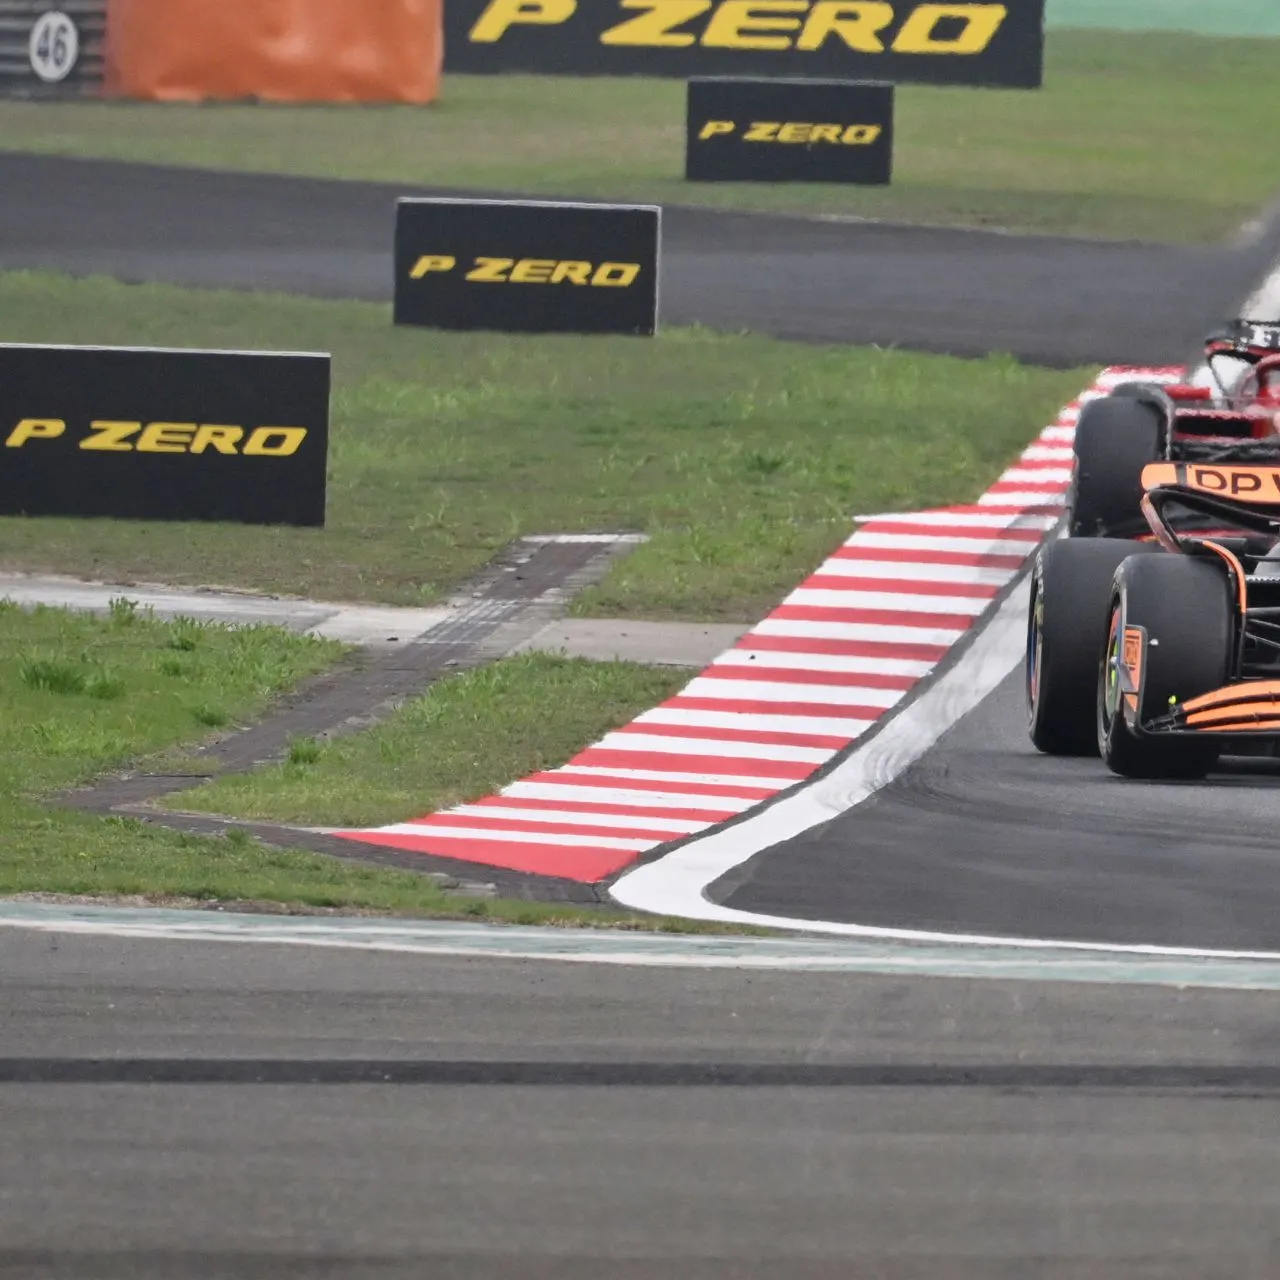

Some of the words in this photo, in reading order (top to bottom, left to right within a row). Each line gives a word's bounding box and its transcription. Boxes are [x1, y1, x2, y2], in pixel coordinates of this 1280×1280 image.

[36, 23, 68, 66] 46
[699, 121, 735, 140] P
[743, 122, 881, 145] ZERO
[410, 255, 456, 279] P
[466, 257, 641, 287] ZERO
[5, 419, 66, 447] P
[79, 420, 308, 456] ZERO
[1195, 469, 1262, 495] DP
